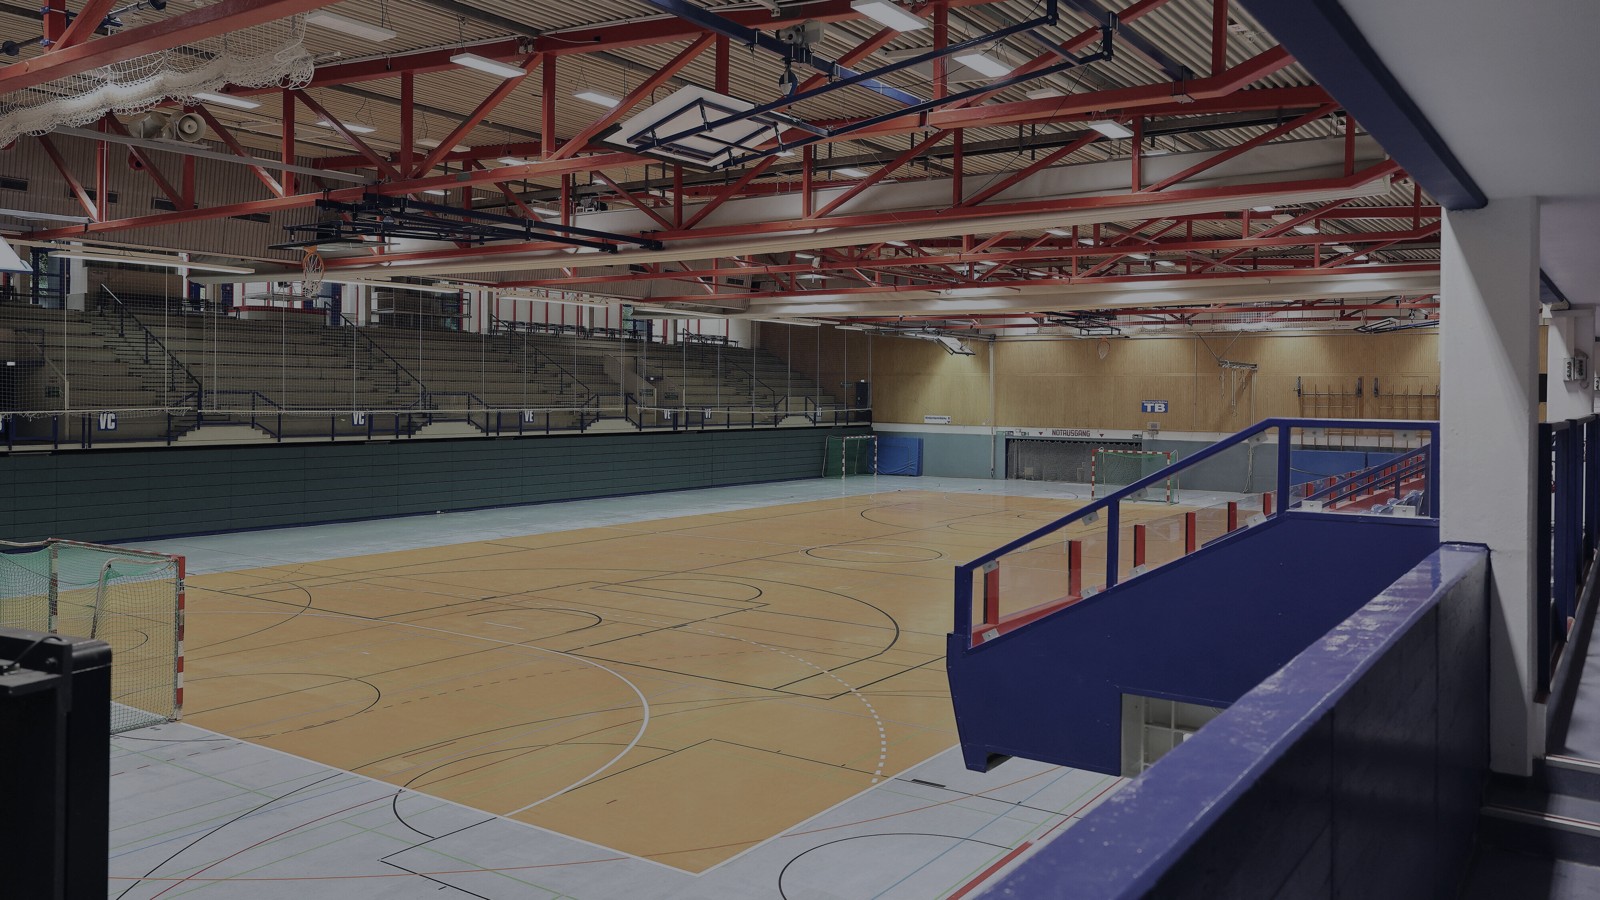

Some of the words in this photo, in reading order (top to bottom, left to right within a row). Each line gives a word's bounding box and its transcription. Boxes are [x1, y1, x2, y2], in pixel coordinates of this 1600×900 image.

[1143, 403, 1165, 412] TB
[100, 413, 116, 430] VC
[353, 411, 365, 425] VC
[1051, 429, 1091, 438] NOTAUSGANG
